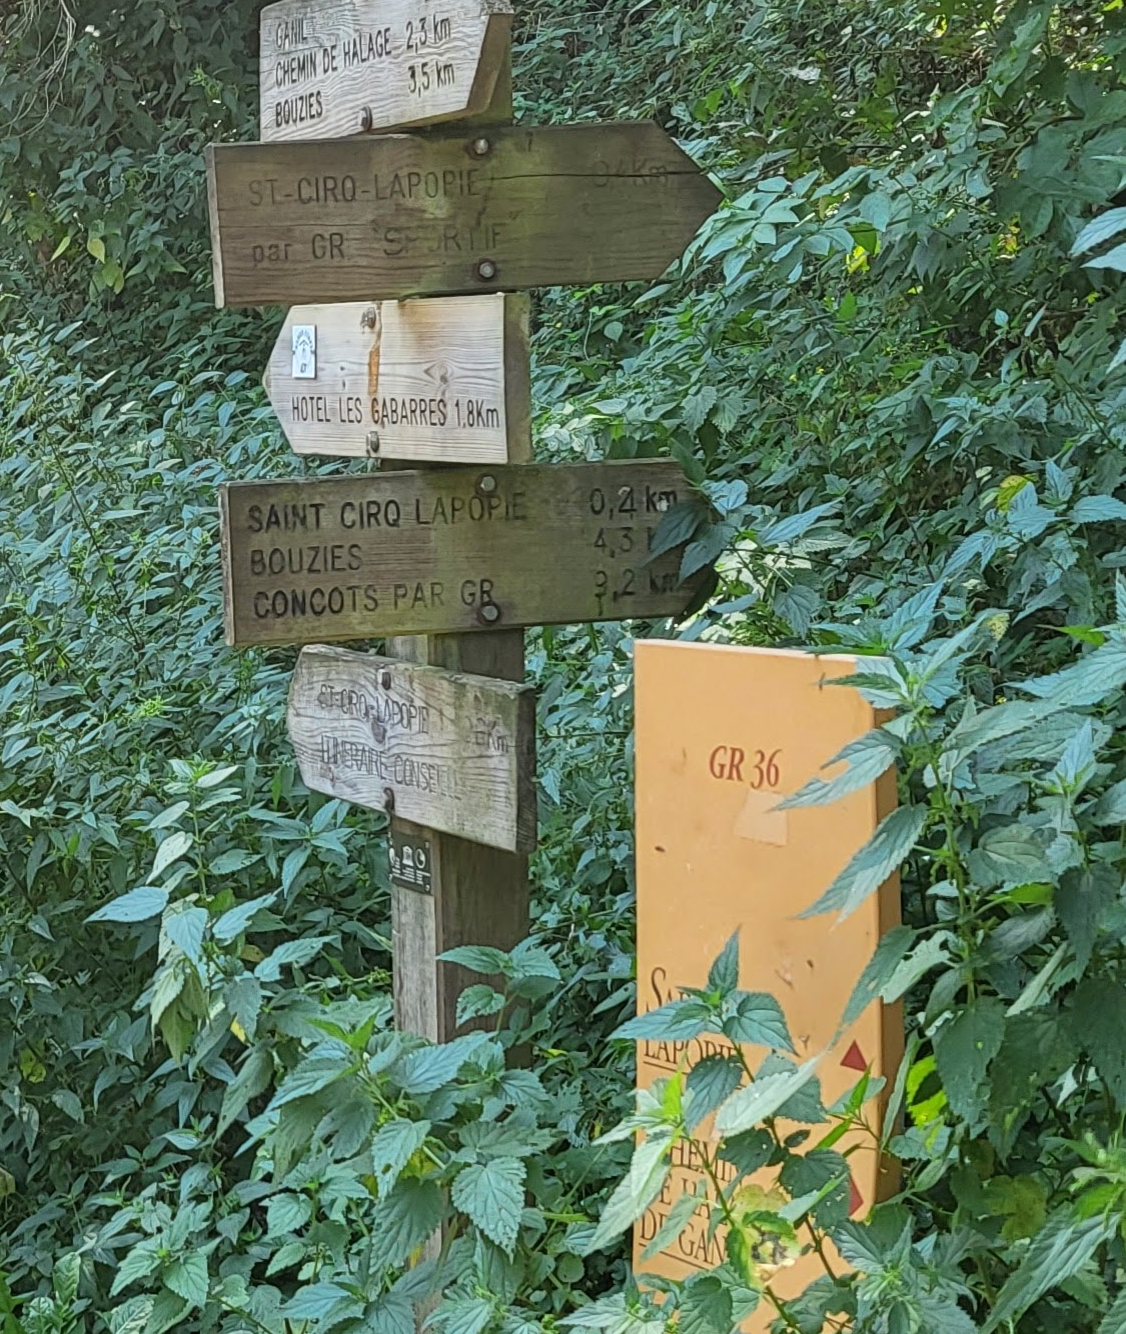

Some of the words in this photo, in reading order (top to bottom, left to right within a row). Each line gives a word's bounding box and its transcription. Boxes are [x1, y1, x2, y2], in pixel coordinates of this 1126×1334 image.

[275, 17, 309, 50] GANIL
[275, 50, 317, 90] CHEMIN
[323, 44, 338, 75] DE
[342, 27, 393, 68] HALAGE
[405, 18, 428, 55] 2,3
[433, 12, 452, 45] km
[275, 89, 324, 129] BOUZIES
[407, 61, 431, 99] 3,5
[435, 60, 456, 89] km
[252, 243, 293, 268] par
[311, 231, 346, 261] GR
[291, 395, 332, 424] HOTEL
[338, 396, 363, 425] LES
[370, 397, 448, 428] GABARRES
[247, 502, 325, 534] SAINT
[340, 498, 401, 530] CIRQ
[415, 491, 526, 526] LAPOPIE
[645, 485, 678, 513] km
[250, 543, 363, 576] BOUZIES
[593, 526, 634, 559] 4,3
[253, 583, 378, 619] CONCOTS
[393, 581, 445, 610] PAR
[460, 578, 495, 609] GR
[709, 745, 745, 782] GR
[750, 748, 783, 790] 36
